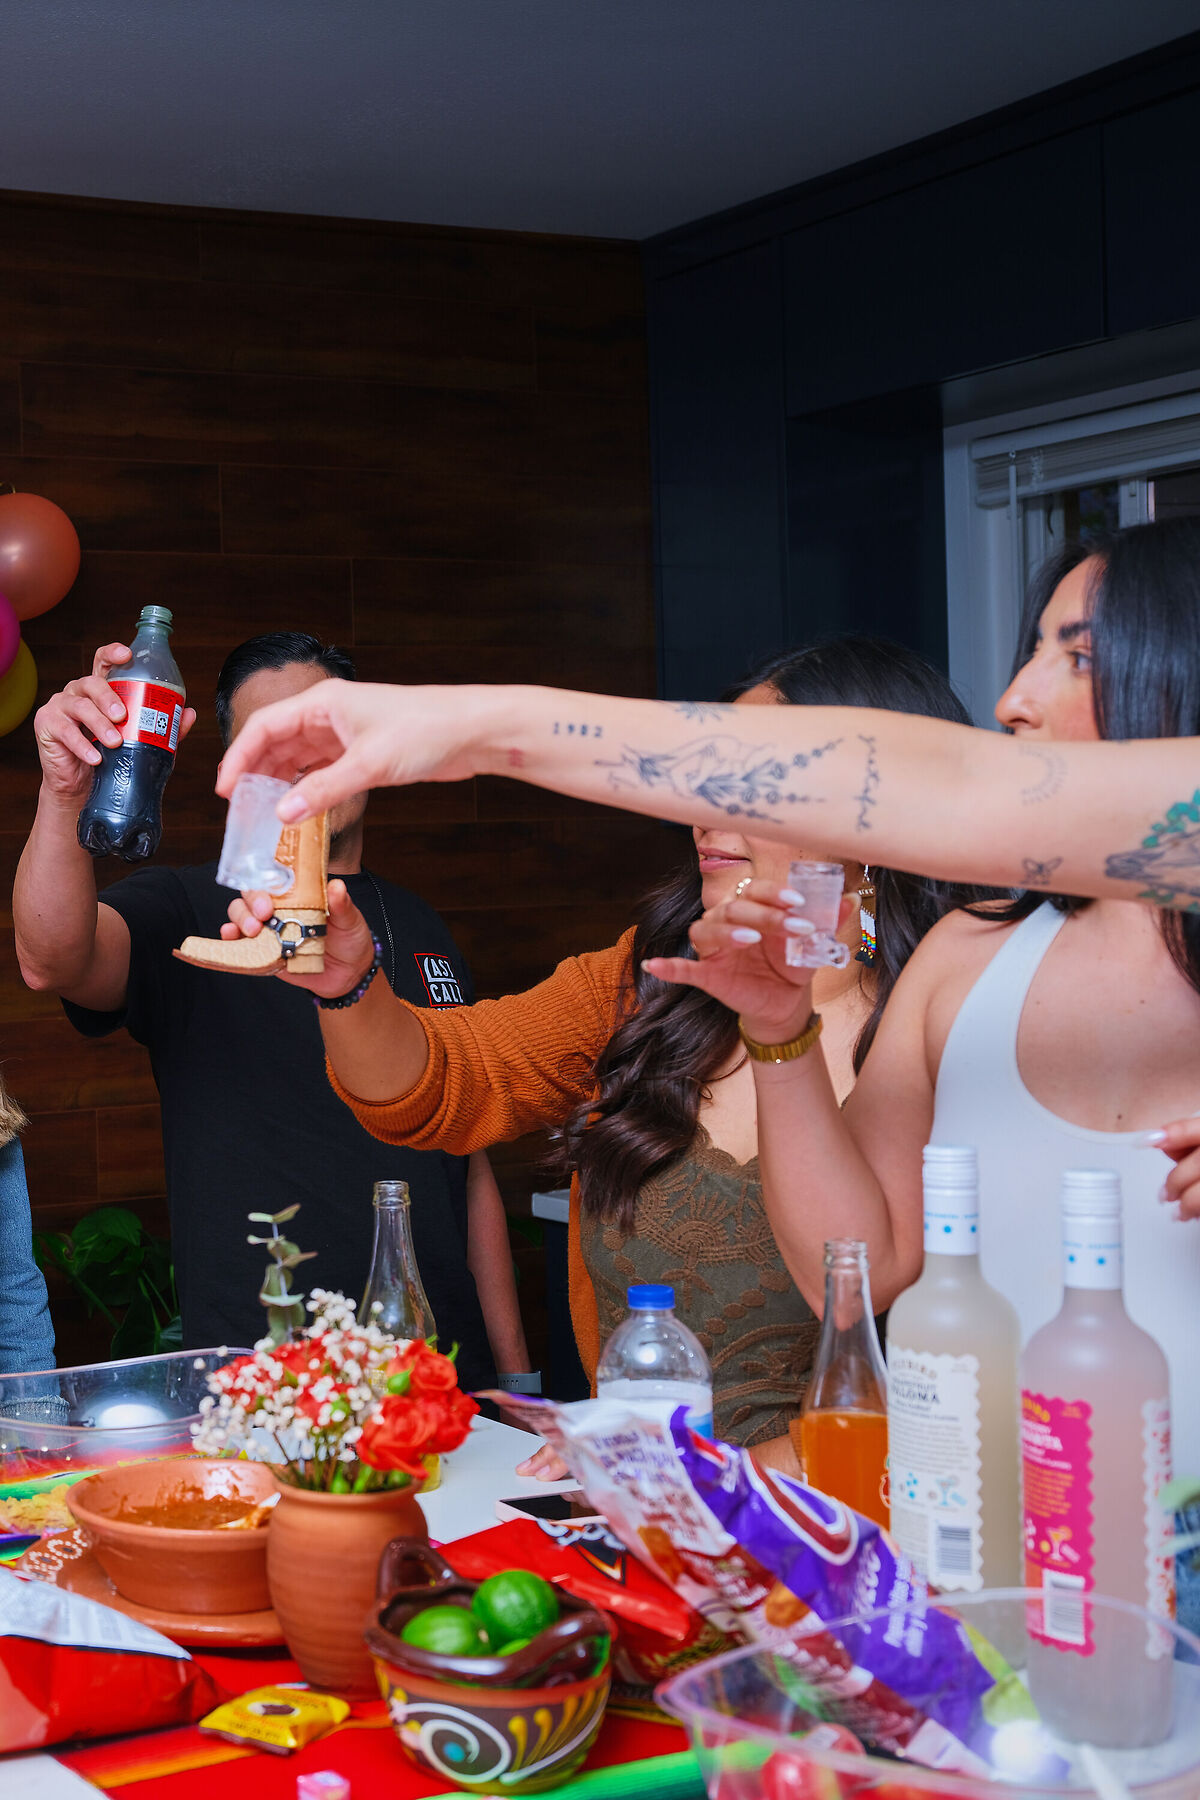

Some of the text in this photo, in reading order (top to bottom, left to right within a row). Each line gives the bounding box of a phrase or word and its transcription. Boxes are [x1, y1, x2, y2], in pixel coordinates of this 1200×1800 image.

[553, 722, 603, 738] 1982
[424, 957, 457, 983] LAST
[430, 984, 464, 1003] CALL
